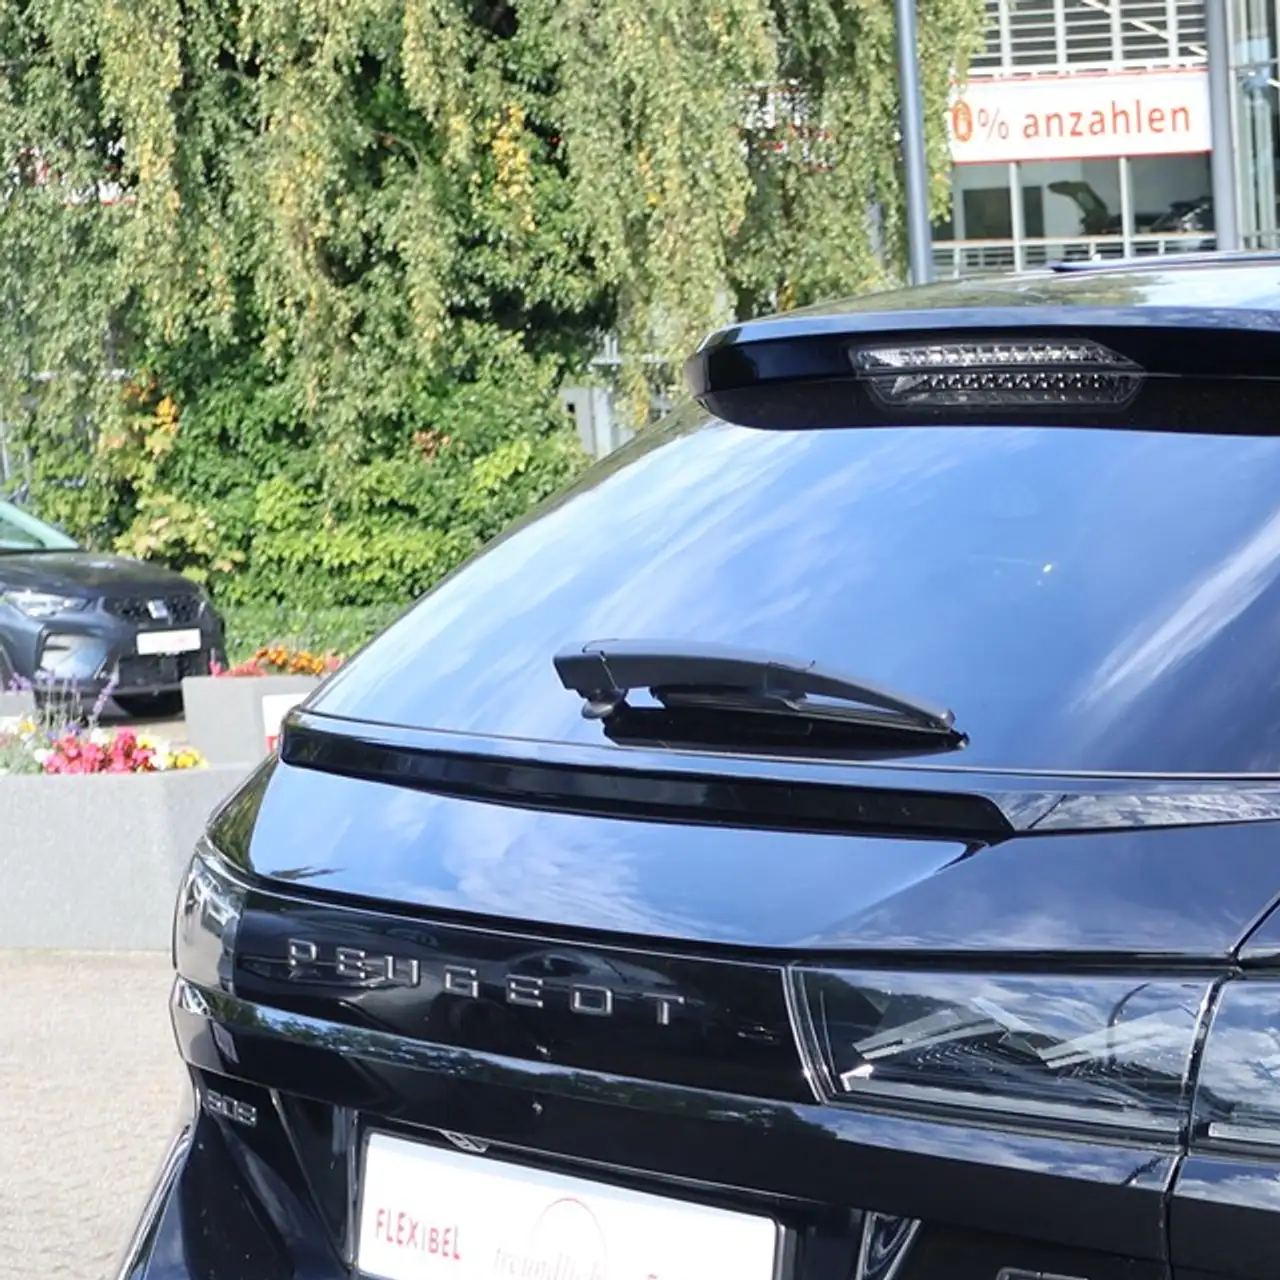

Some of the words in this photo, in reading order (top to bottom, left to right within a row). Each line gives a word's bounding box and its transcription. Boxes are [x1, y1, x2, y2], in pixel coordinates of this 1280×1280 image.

[1023, 99, 1190, 139] anzahlen
[287, 938, 685, 1026] PEUGEOT
[375, 1208, 461, 1261] FLEXIBEL
